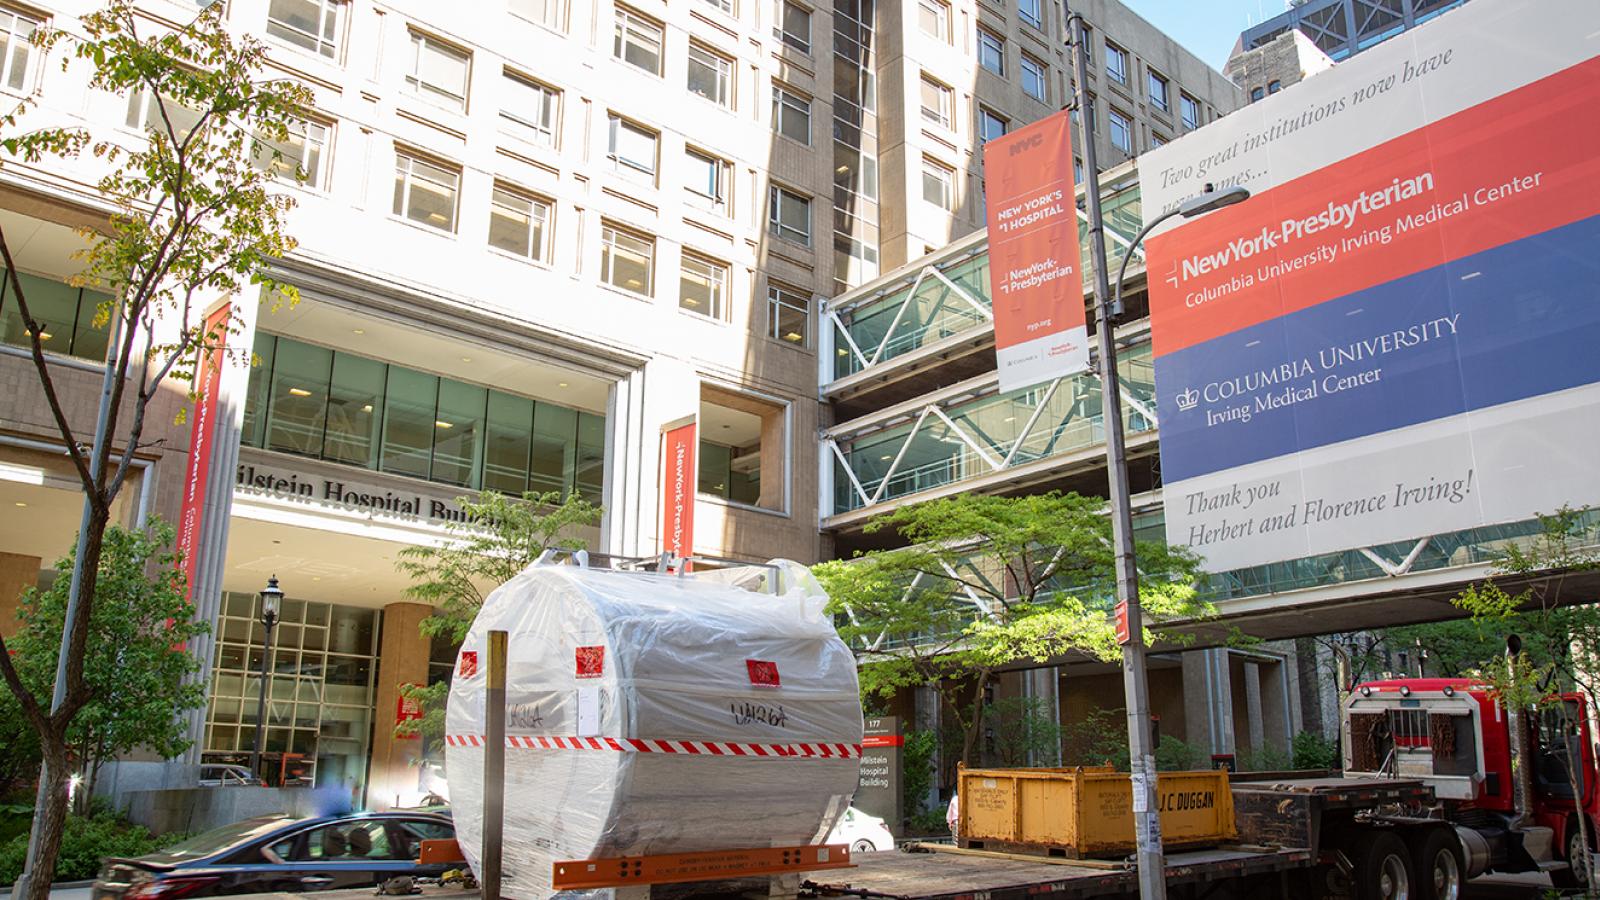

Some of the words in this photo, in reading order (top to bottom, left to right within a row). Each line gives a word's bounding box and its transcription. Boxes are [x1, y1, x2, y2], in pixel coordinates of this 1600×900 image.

[1160, 167, 1193, 189] Two
[1196, 142, 1238, 179] great
[1243, 96, 1346, 153] institutions
[1352, 73, 1396, 106] now
[1401, 46, 1453, 86] have
[998, 204, 1022, 221] NEW
[1024, 190, 1063, 211] YORK'S
[1009, 204, 1065, 230] HOSPITAL
[1181, 172, 1435, 281] NewYork-Presbyterian
[1185, 274, 1254, 309] Columbia
[1257, 244, 1338, 282] University
[1340, 224, 1393, 254] Irving
[1396, 193, 1470, 234] Medical
[1473, 171, 1543, 206] Center
[1010, 265, 1073, 292] Presbyterian
[1203, 359, 1314, 404] COLUMBIA
[1318, 313, 1462, 370] UNIVERSITY
[1206, 401, 1251, 427] Irving
[1254, 380, 1318, 414] Medical
[1322, 365, 1382, 393] Center
[237, 465, 313, 496] ilstein
[323, 480, 420, 518] Hospital
[1185, 488, 1242, 516] Thank
[1243, 478, 1281, 509] you
[1187, 518, 1254, 548] Herbert
[1259, 505, 1297, 534] and
[1302, 494, 1386, 526] Florence
[1394, 468, 1475, 509] Irving!
[869, 719, 881, 729] 177
[860, 766, 889, 777] Hospital
[861, 755, 888, 765] Milstein
[860, 778, 889, 789] Building
[1177, 791, 1215, 811] DUGGAN
